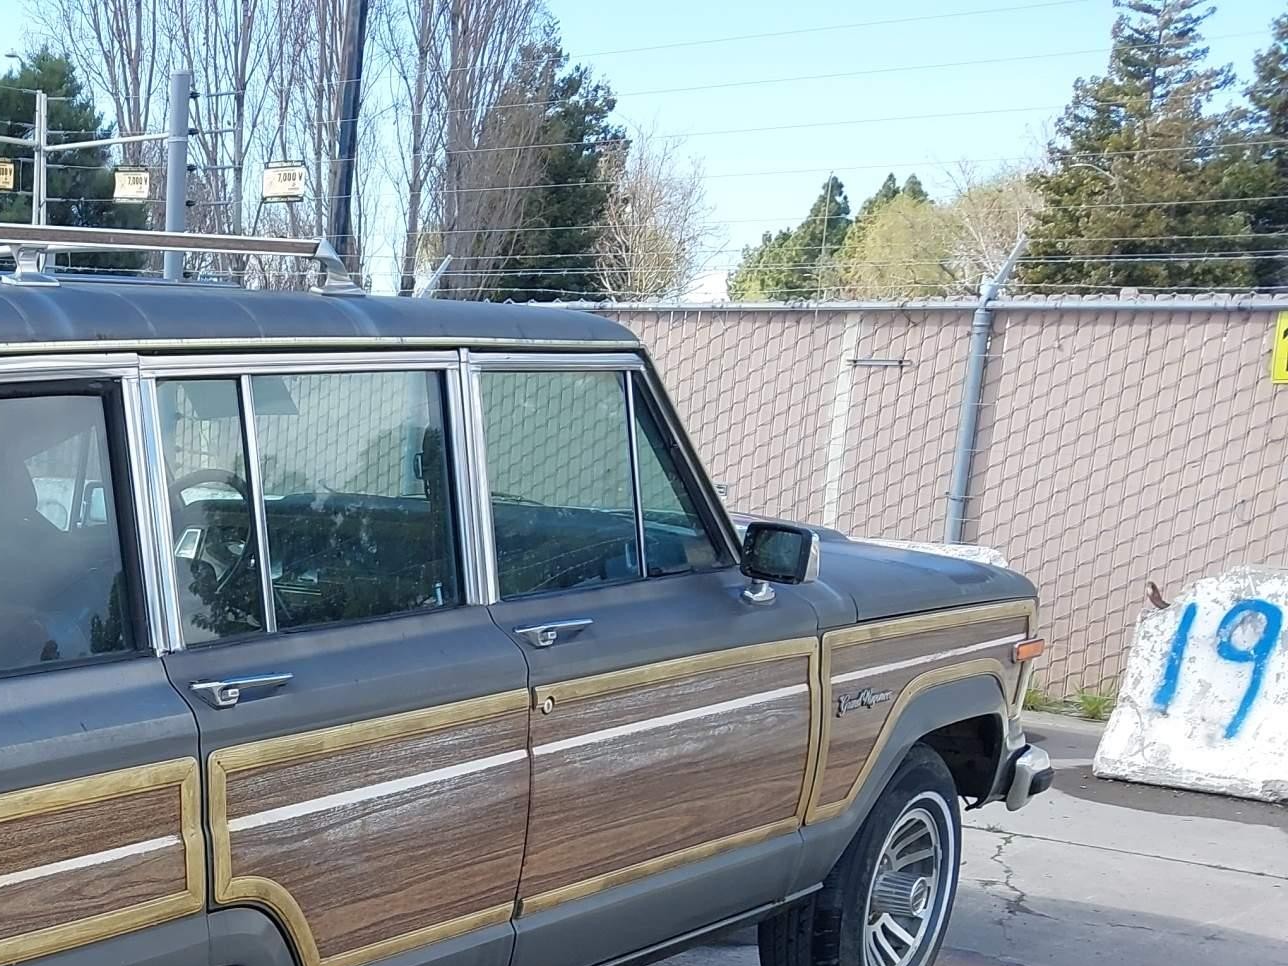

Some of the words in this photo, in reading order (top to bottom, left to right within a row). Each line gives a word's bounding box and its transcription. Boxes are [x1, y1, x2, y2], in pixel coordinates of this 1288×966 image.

[277, 173, 297, 183] 7,000
[298, 172, 303, 181] V
[1153, 597, 1283, 740] 19
